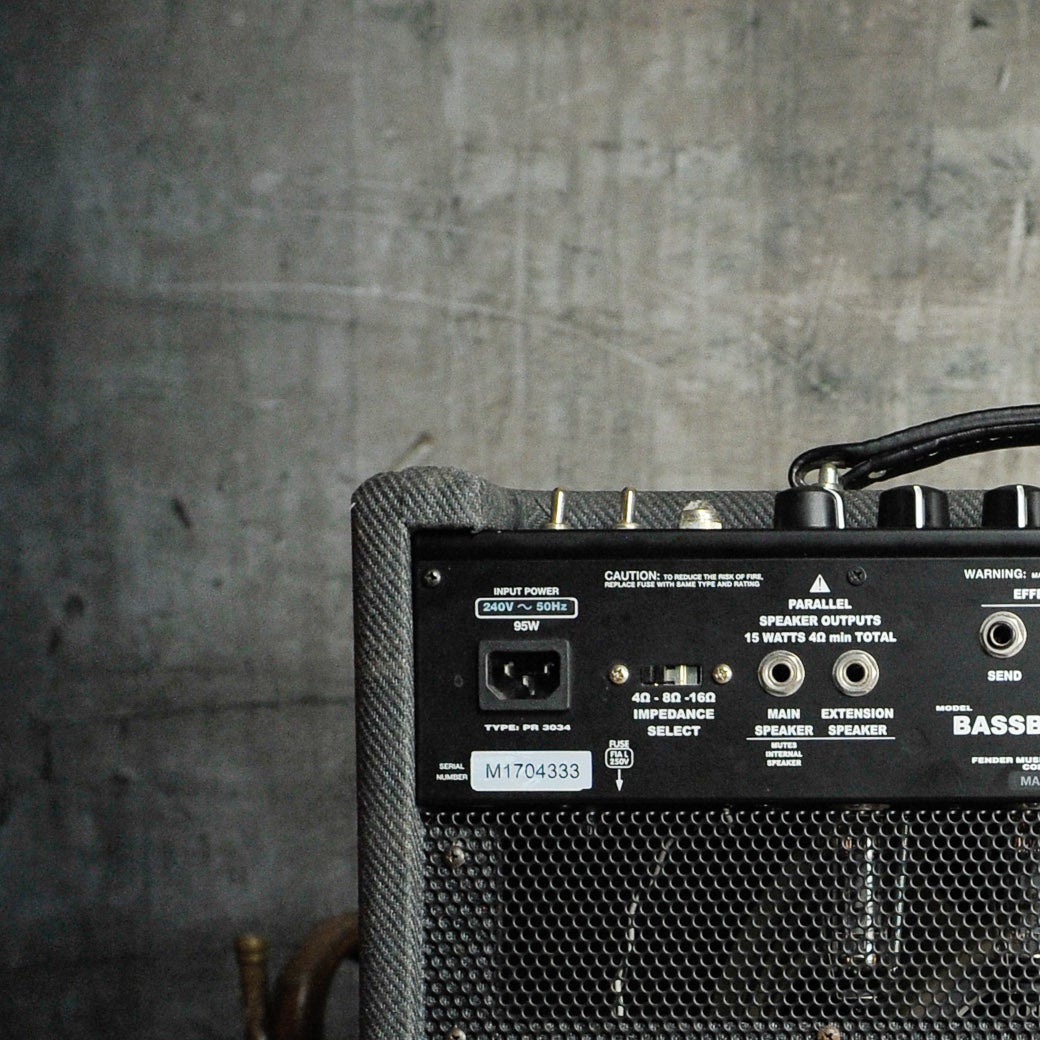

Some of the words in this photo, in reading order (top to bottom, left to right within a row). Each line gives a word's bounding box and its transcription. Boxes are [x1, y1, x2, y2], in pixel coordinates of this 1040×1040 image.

[604, 571, 660, 580] CAUTION:
[964, 569, 1026, 579] WARNING:
[493, 587, 522, 595] INPUT
[524, 587, 559, 595] POWER
[482, 602, 513, 611] 240V
[536, 602, 567, 611] 50Hz
[788, 599, 852, 609] PARALLEL
[513, 621, 539, 631] 95W
[759, 616, 818, 626] SPEAKER
[821, 616, 881, 626] OUTPUTS
[744, 632, 759, 642] 15
[762, 632, 806, 642] WATTS
[829, 632, 852, 642] min
[855, 632, 897, 642] TOTAL
[987, 671, 1022, 681] SEND
[633, 709, 715, 719] IMPEDANCE
[767, 708, 801, 718] MAIN
[821, 708, 894, 718] EXTENSION
[647, 726, 700, 736] SELECT
[755, 725, 813, 735] SPEAKER
[828, 725, 887, 735] SPEAKER
[609, 740, 629, 748] FUSE
[485, 763, 580, 778] M1704333
